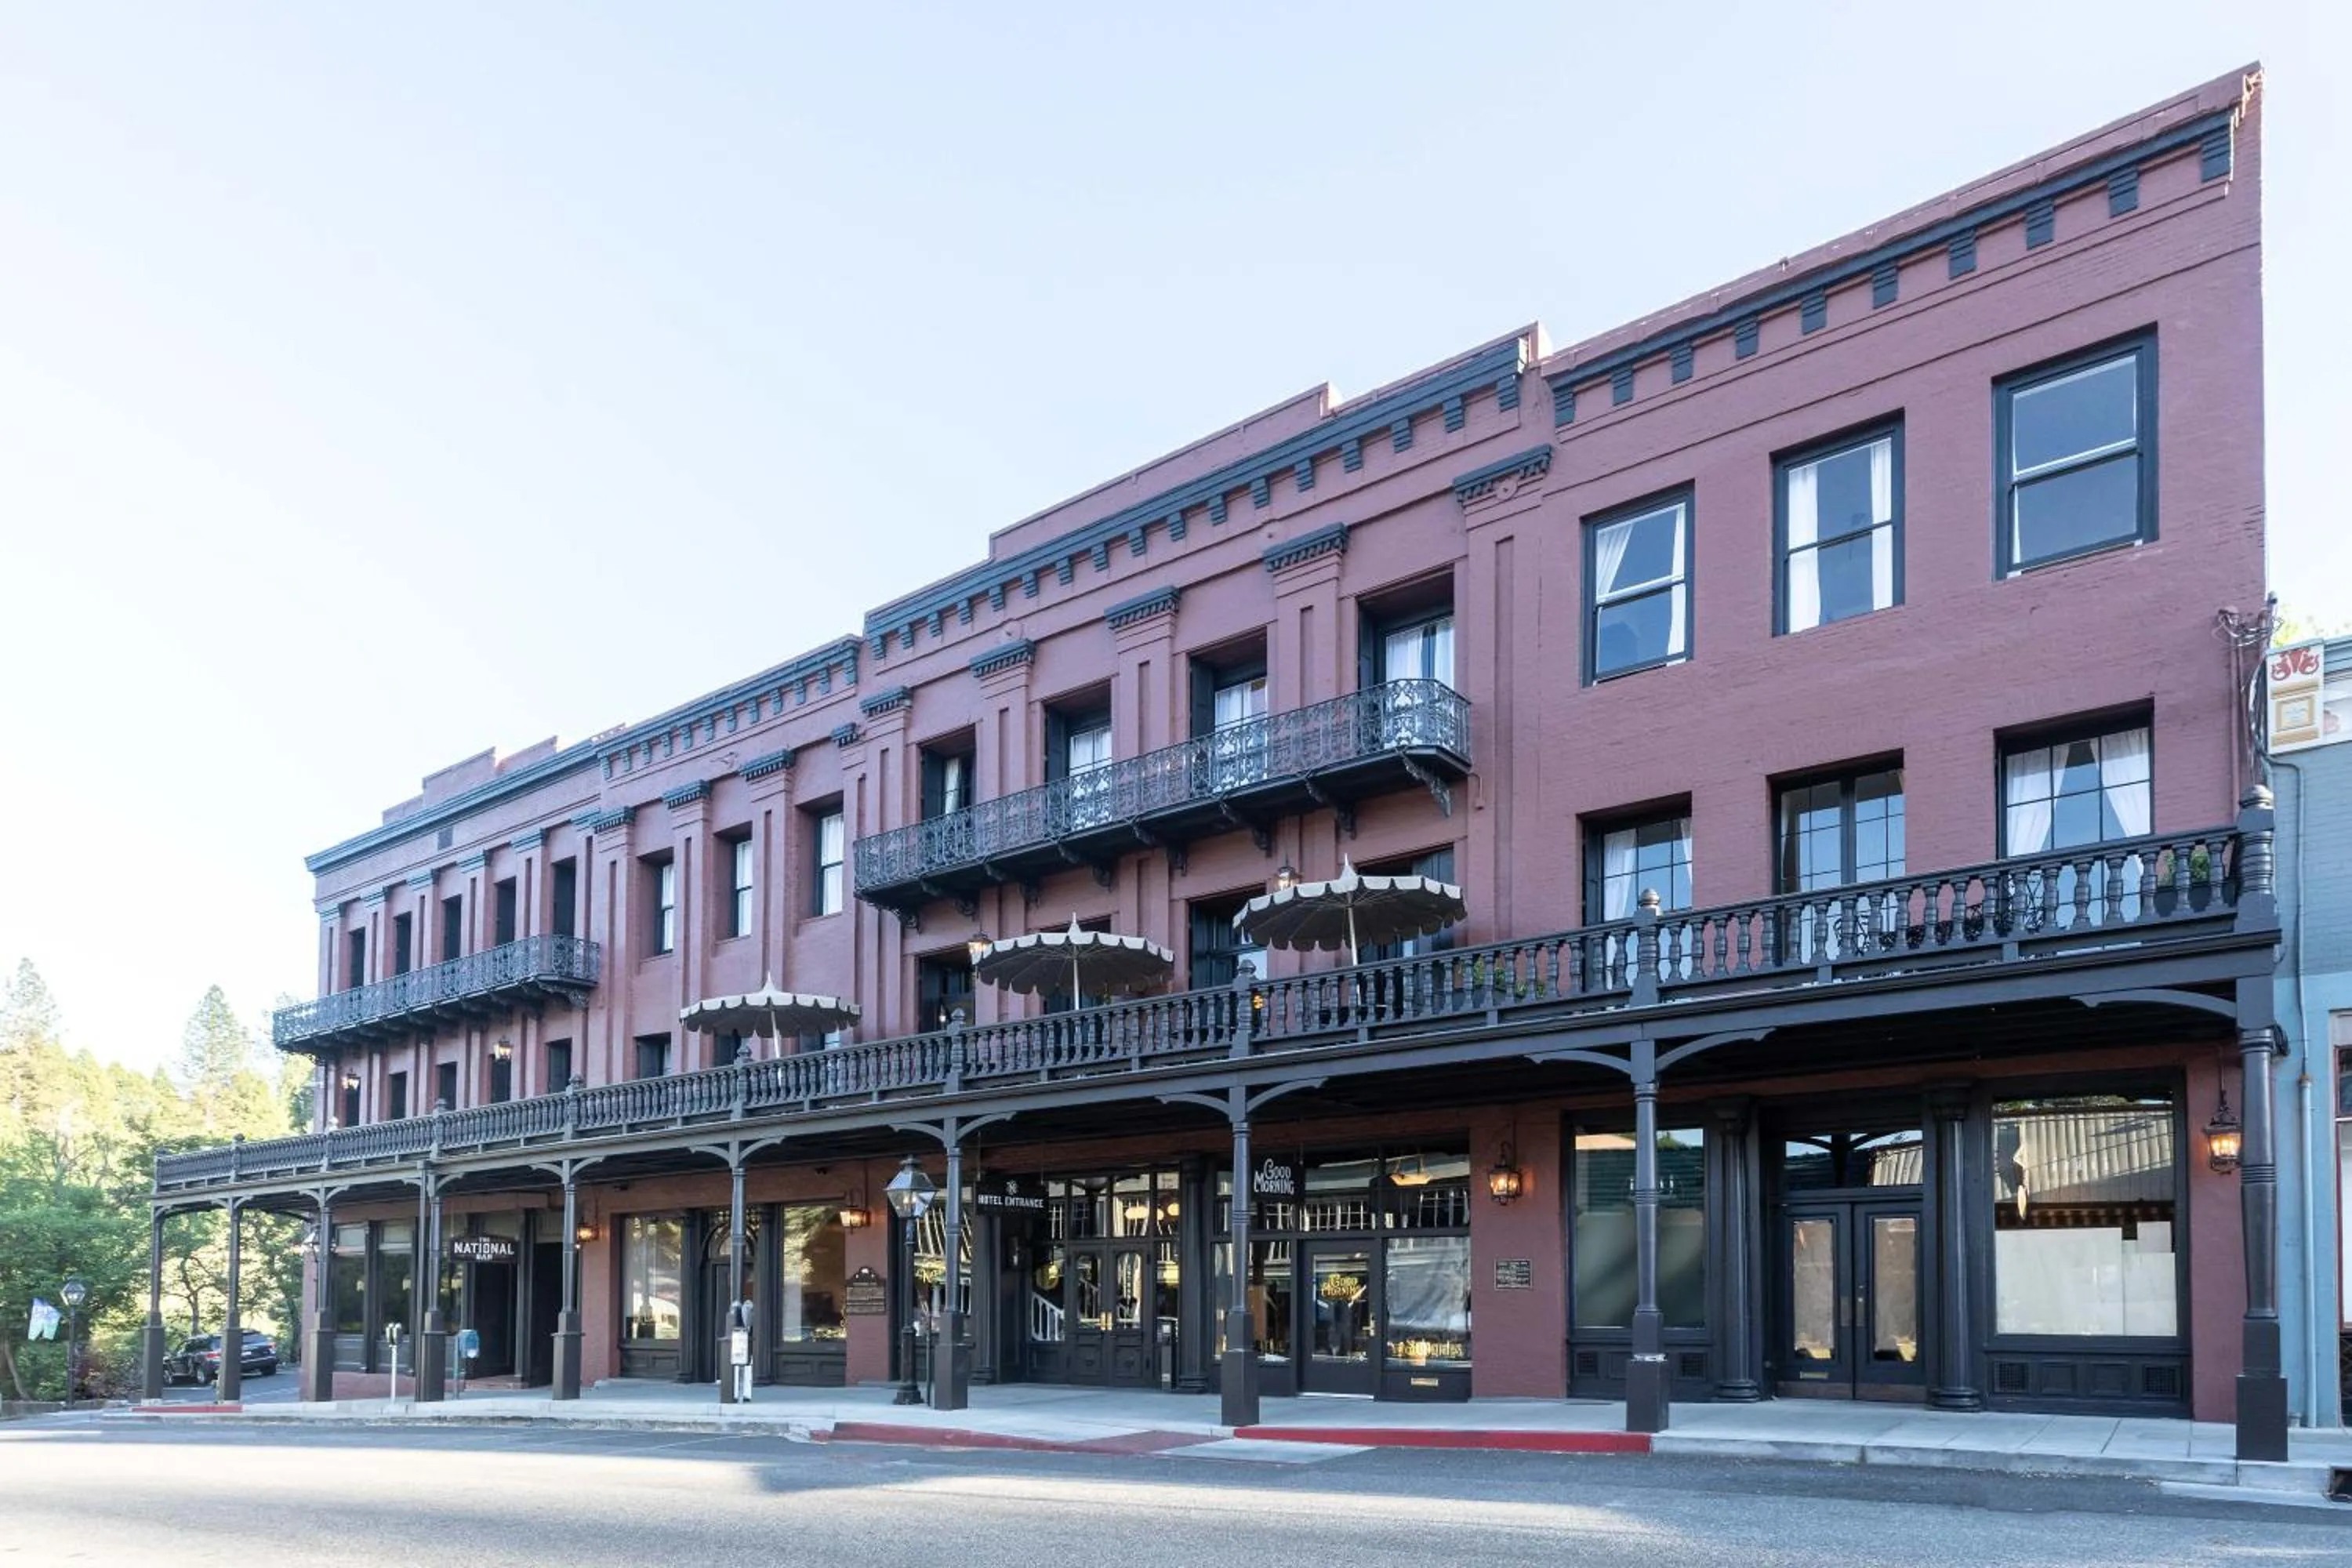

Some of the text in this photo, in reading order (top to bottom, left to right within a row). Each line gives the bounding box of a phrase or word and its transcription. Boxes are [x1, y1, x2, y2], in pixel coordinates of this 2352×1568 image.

[1263, 1158, 1291, 1180] GOOD
[1254, 1171, 1294, 1196] MORNING
[978, 1194, 1044, 1208] HOTEL ENTRANCE
[454, 1241, 515, 1255] NATIONAL
